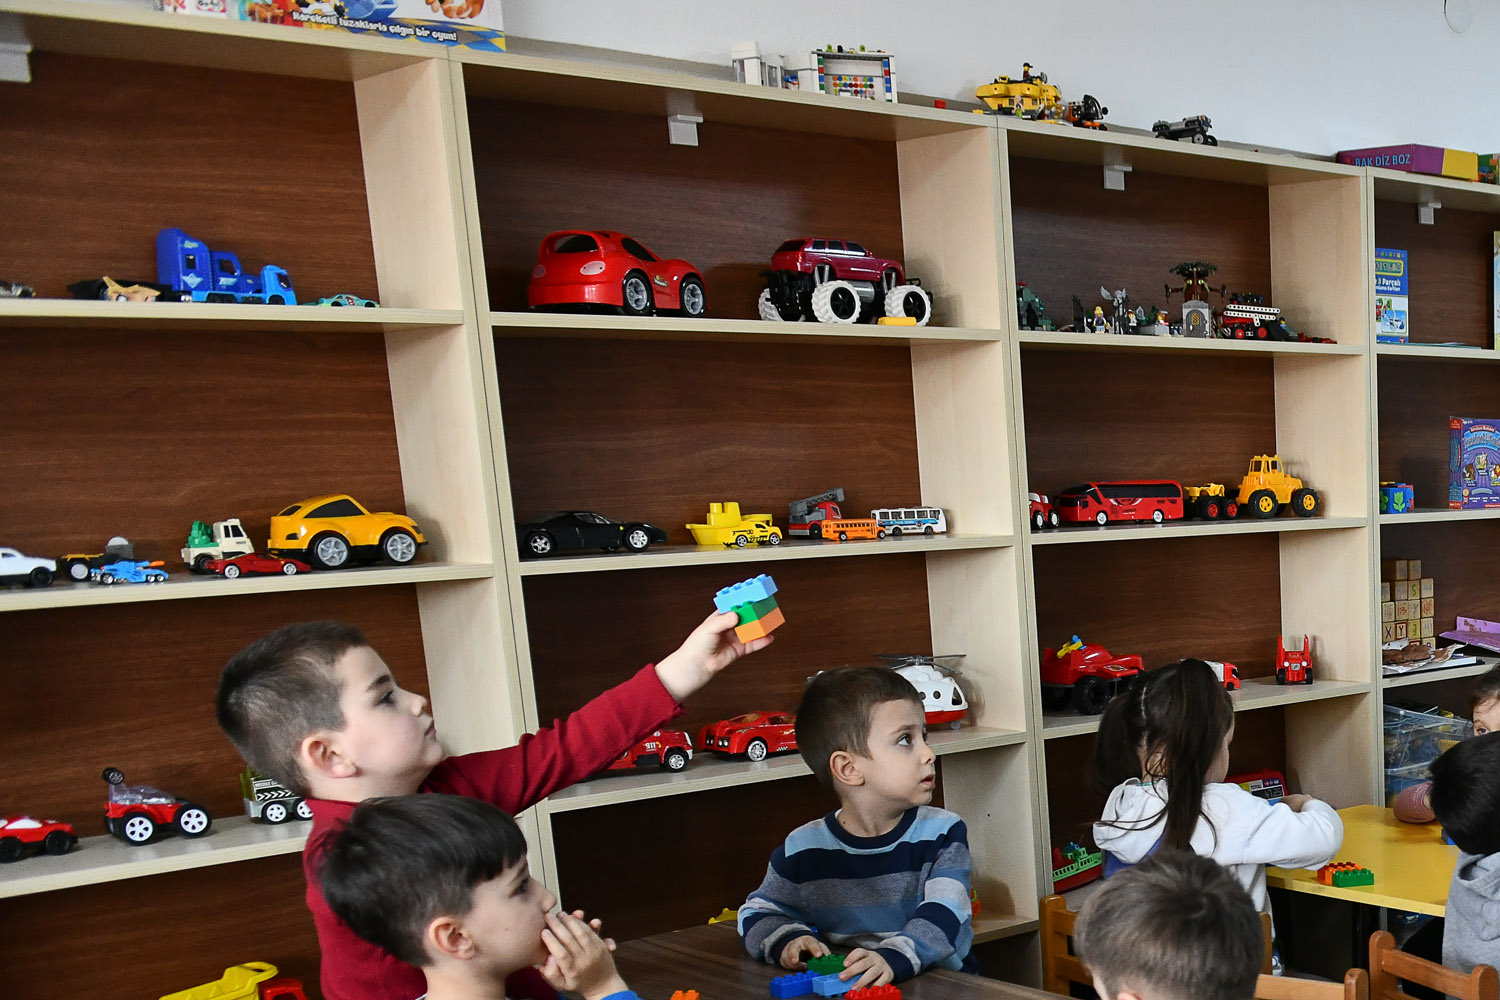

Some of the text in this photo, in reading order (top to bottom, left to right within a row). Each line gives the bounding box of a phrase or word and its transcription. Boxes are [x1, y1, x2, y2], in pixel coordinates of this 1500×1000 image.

[416, 27, 430, 37] bir
[1355, 153, 1410, 167] BAK DİZ BOZ
